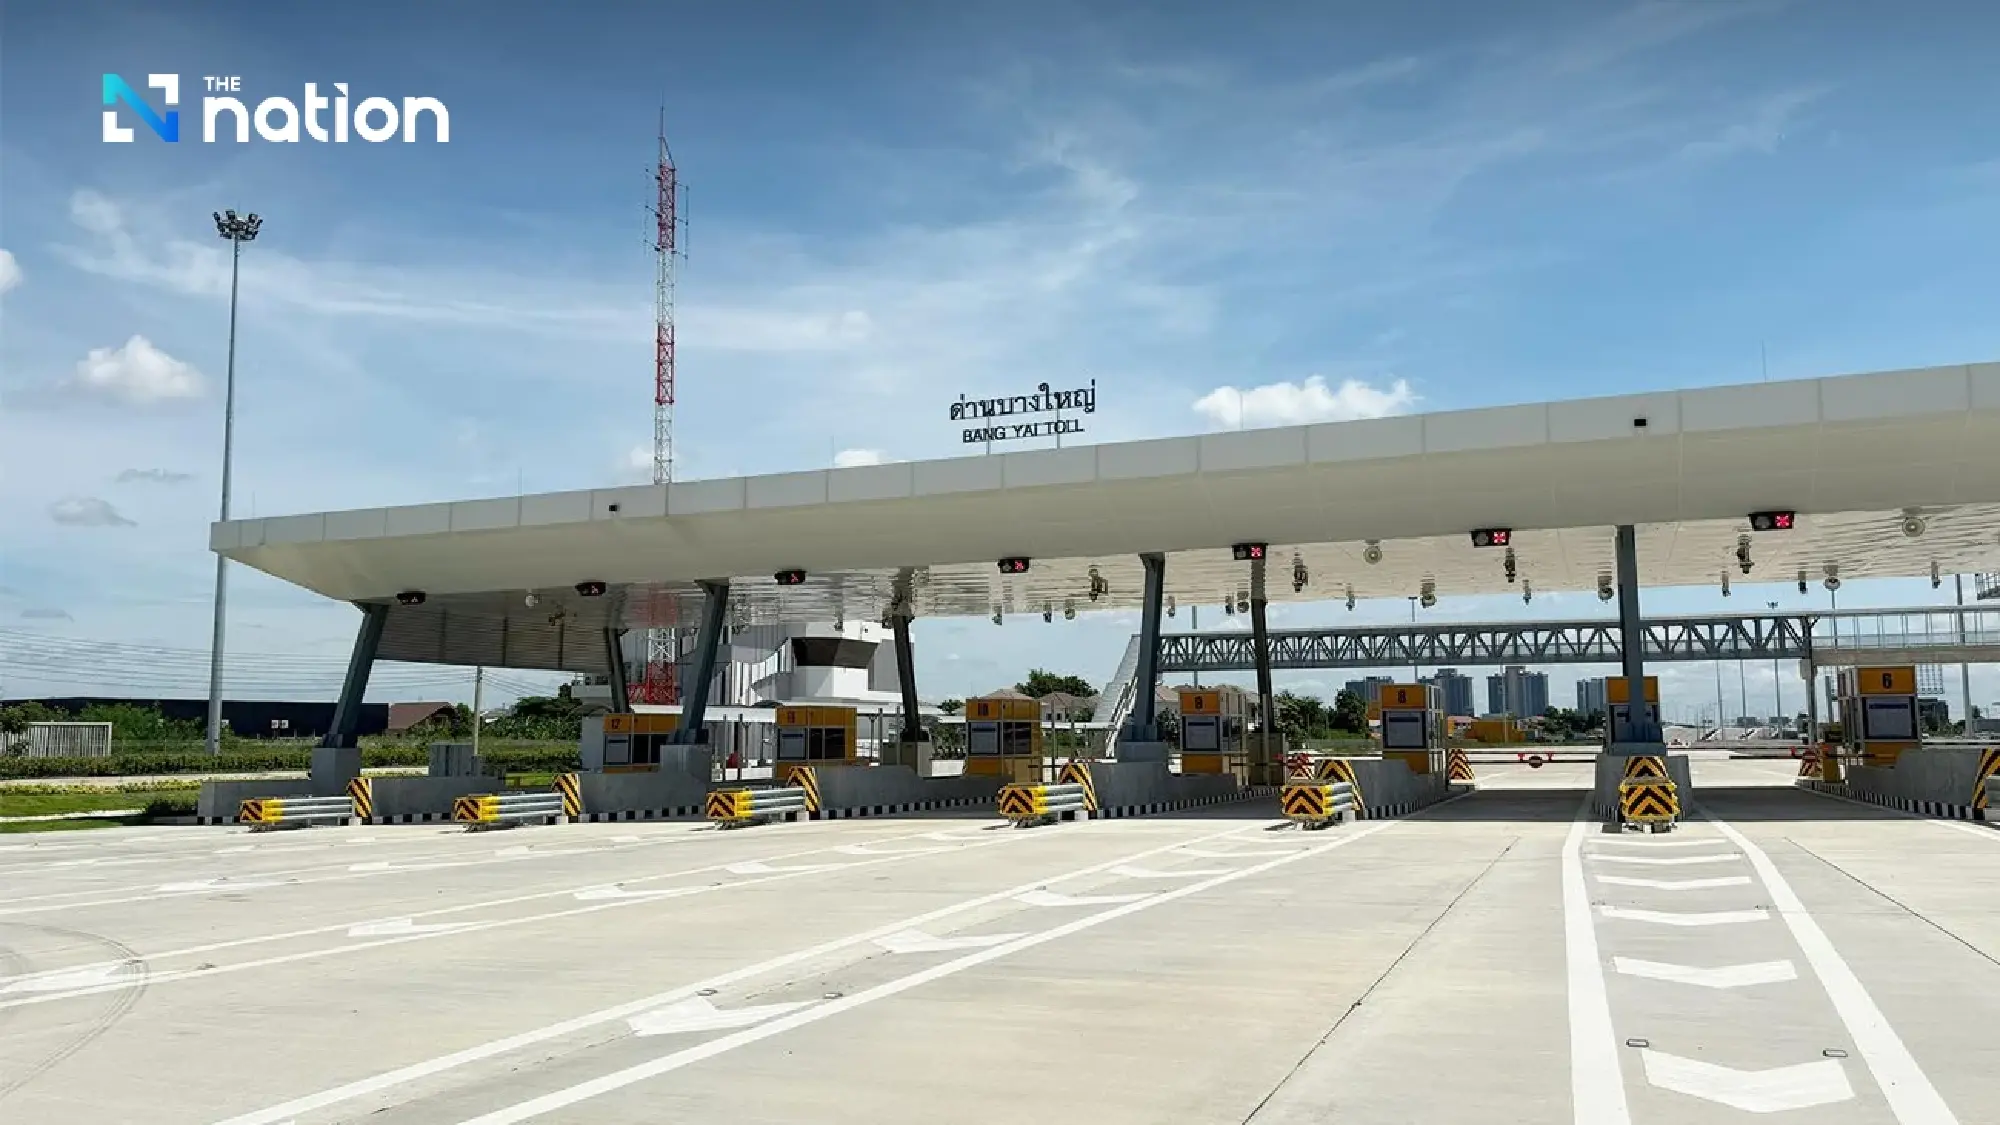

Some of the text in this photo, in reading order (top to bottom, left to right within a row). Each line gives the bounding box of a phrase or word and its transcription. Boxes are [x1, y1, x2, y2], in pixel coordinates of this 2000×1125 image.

[949, 379, 1096, 420] ด่านบางใหญ่
[962, 419, 1086, 443] BANG YAI TOLL
[1882, 672, 1893, 690] 6
